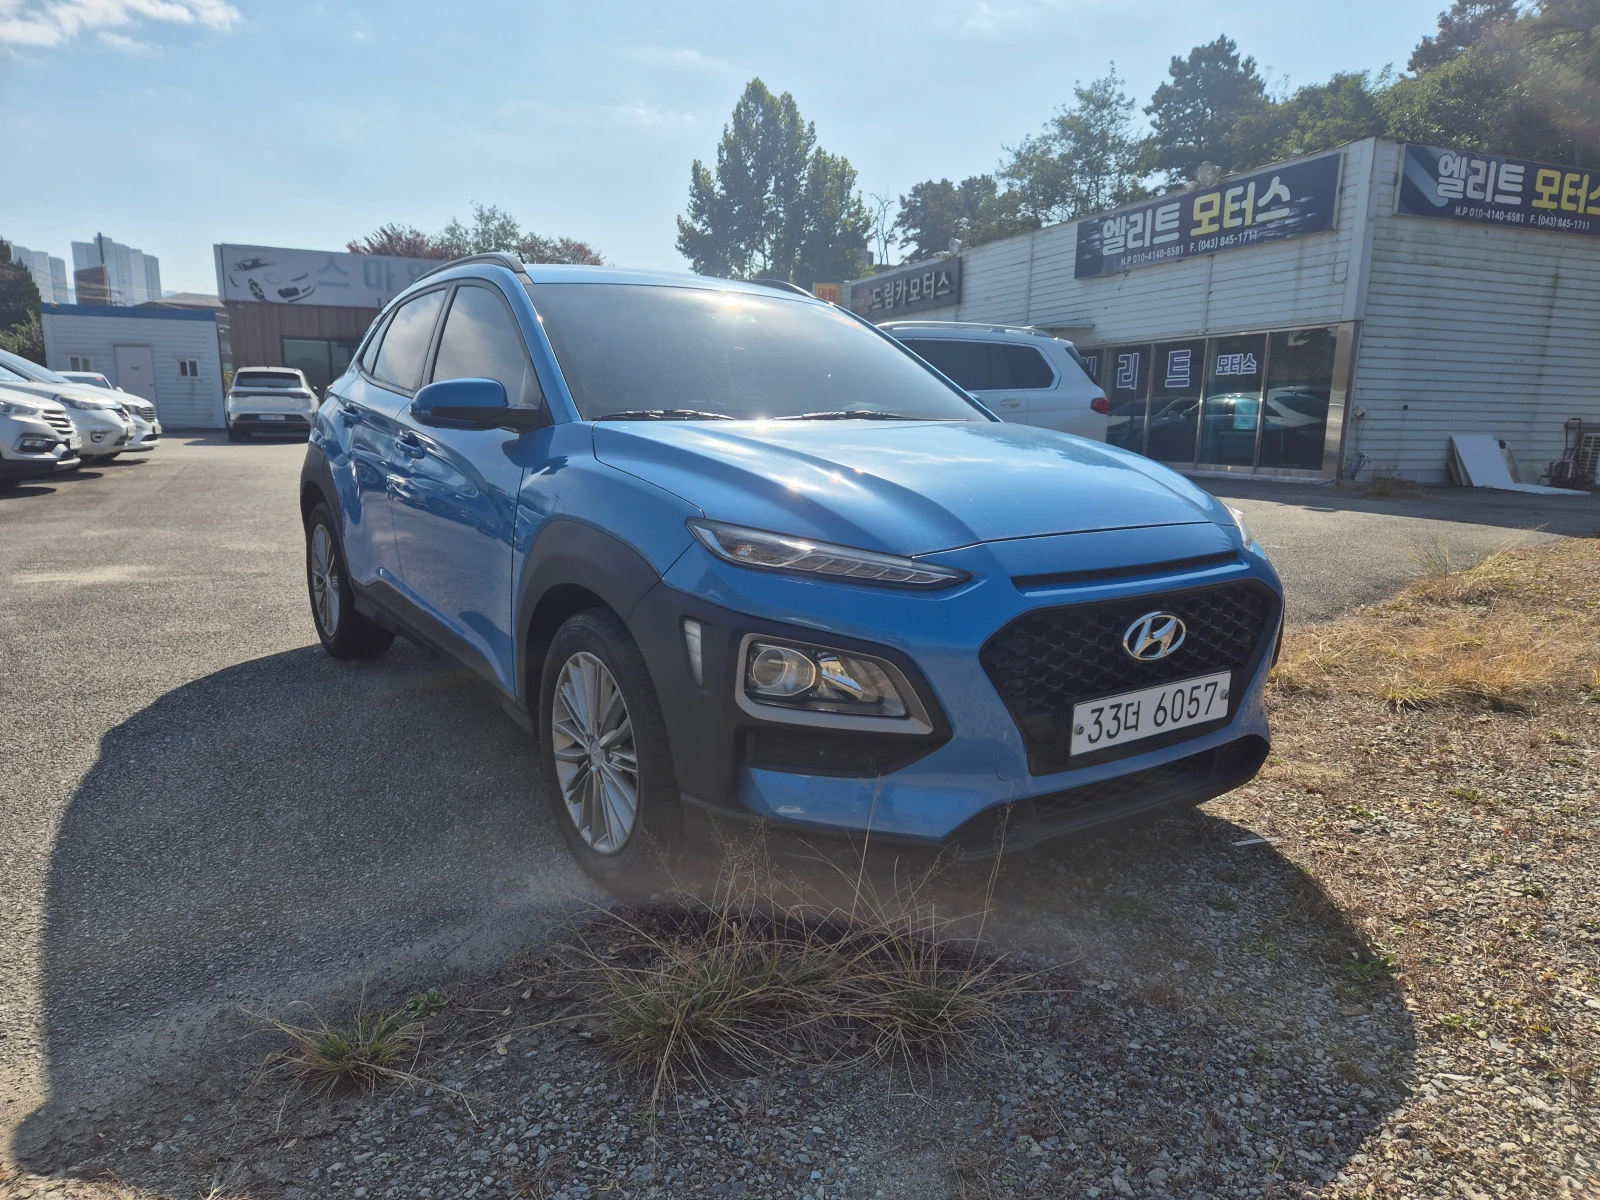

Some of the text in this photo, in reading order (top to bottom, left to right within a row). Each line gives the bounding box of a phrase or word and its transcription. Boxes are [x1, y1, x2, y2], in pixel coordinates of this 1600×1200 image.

[1436, 153, 1525, 206] 엘리트
[1102, 175, 1291, 256] 엘리트 모터스
[1469, 207, 1525, 223] 010-4140-6581
[1538, 214, 1557, 228] (043)
[1557, 217, 1590, 231] 845-1711
[1132, 244, 1184, 264] 010-4140-6581
[1198, 236, 1218, 251] (043)
[1219, 230, 1258, 247] 845-1711
[871, 270, 950, 311] 드림카모터스
[1215, 353, 1257, 376] 모터스
[1087, 681, 1219, 744] 33더 6057
